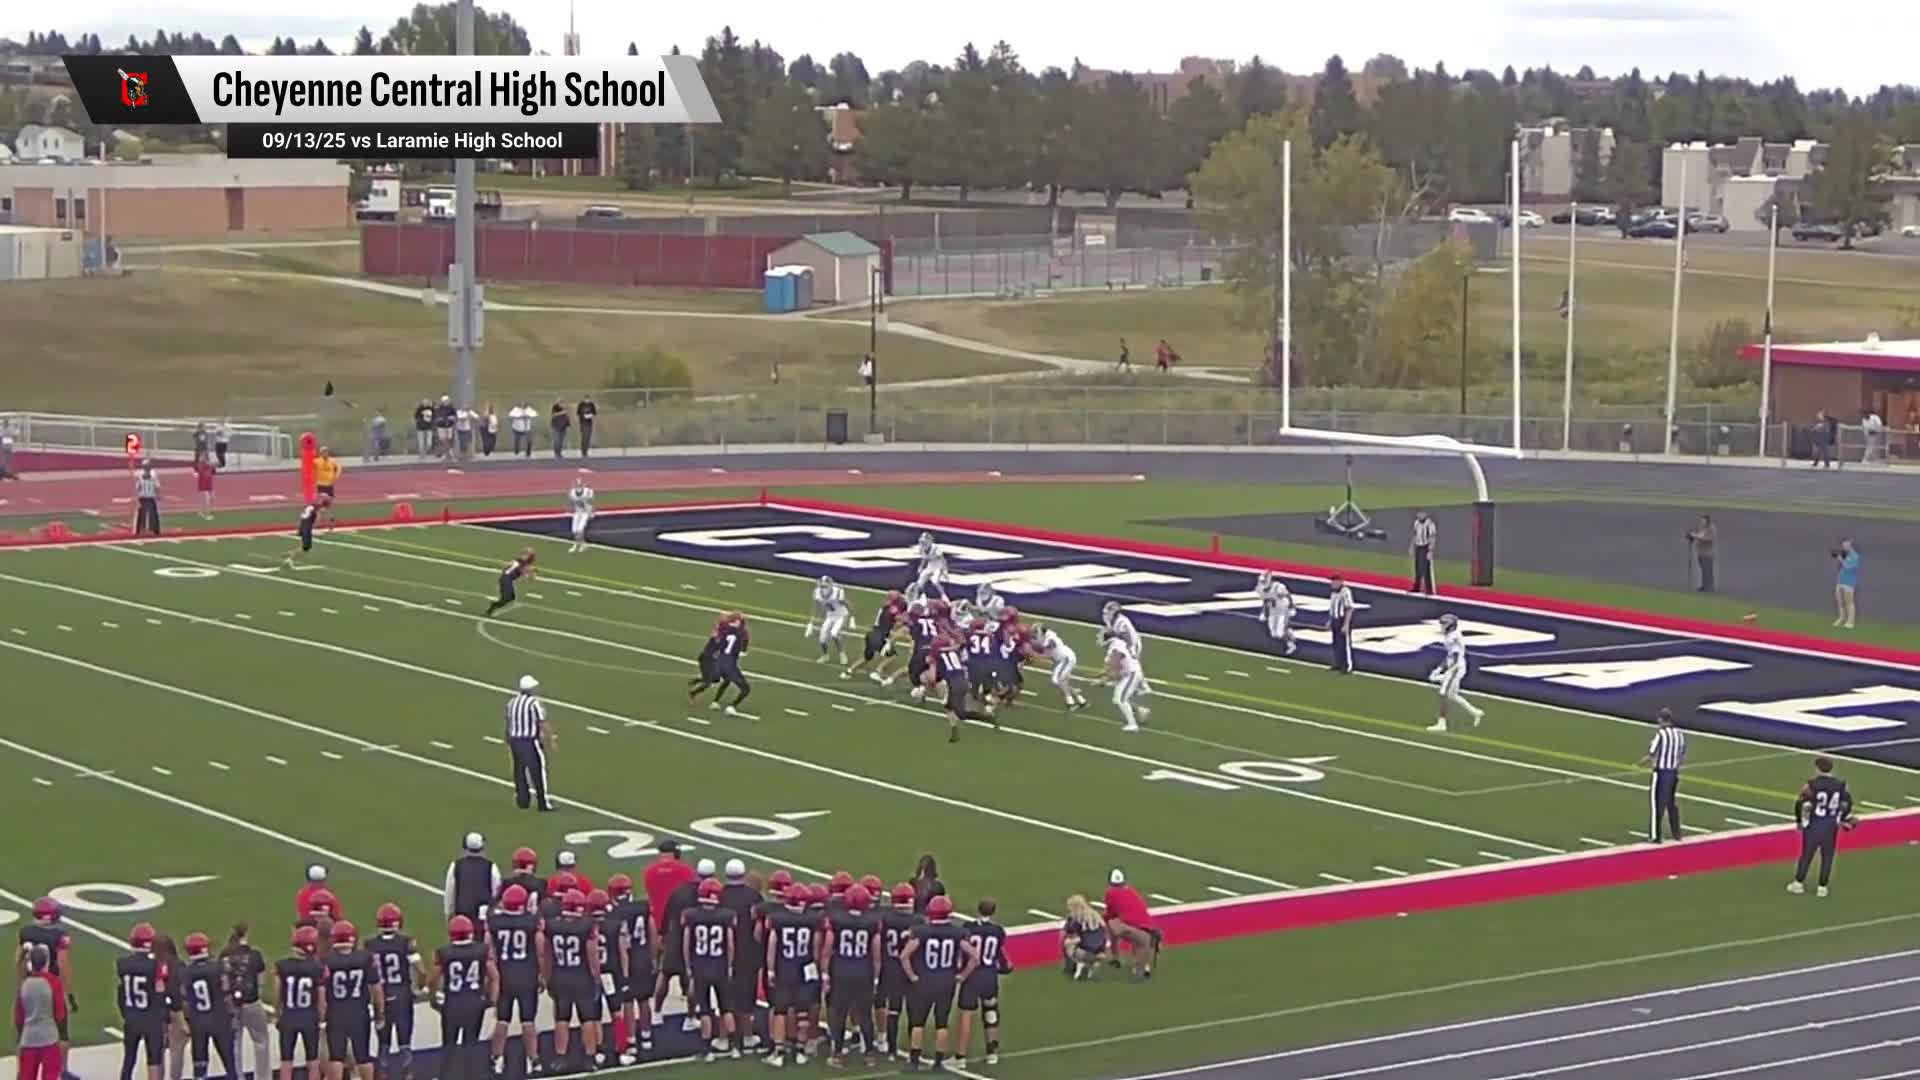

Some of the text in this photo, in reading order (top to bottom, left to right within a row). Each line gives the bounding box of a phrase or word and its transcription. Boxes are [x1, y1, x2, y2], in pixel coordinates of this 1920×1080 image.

[127, 433, 139, 453] 2
[724, 634, 737, 654] 7
[970, 634, 990, 654] 34
[1142, 761, 1325, 790] 10
[1815, 791, 1840, 817] 24
[564, 817, 800, 858] 20
[498, 930, 527, 960] 79
[552, 935, 580, 965] 62
[695, 925, 723, 956] 82
[782, 927, 810, 958] 58
[840, 930, 868, 957] 68
[925, 938, 954, 968] 60
[373, 952, 401, 983] 12
[449, 960, 480, 992] 64
[123, 975, 148, 1008] 15
[192, 979, 210, 1011] 9
[286, 976, 313, 1008] 16
[332, 969, 363, 998] 67
